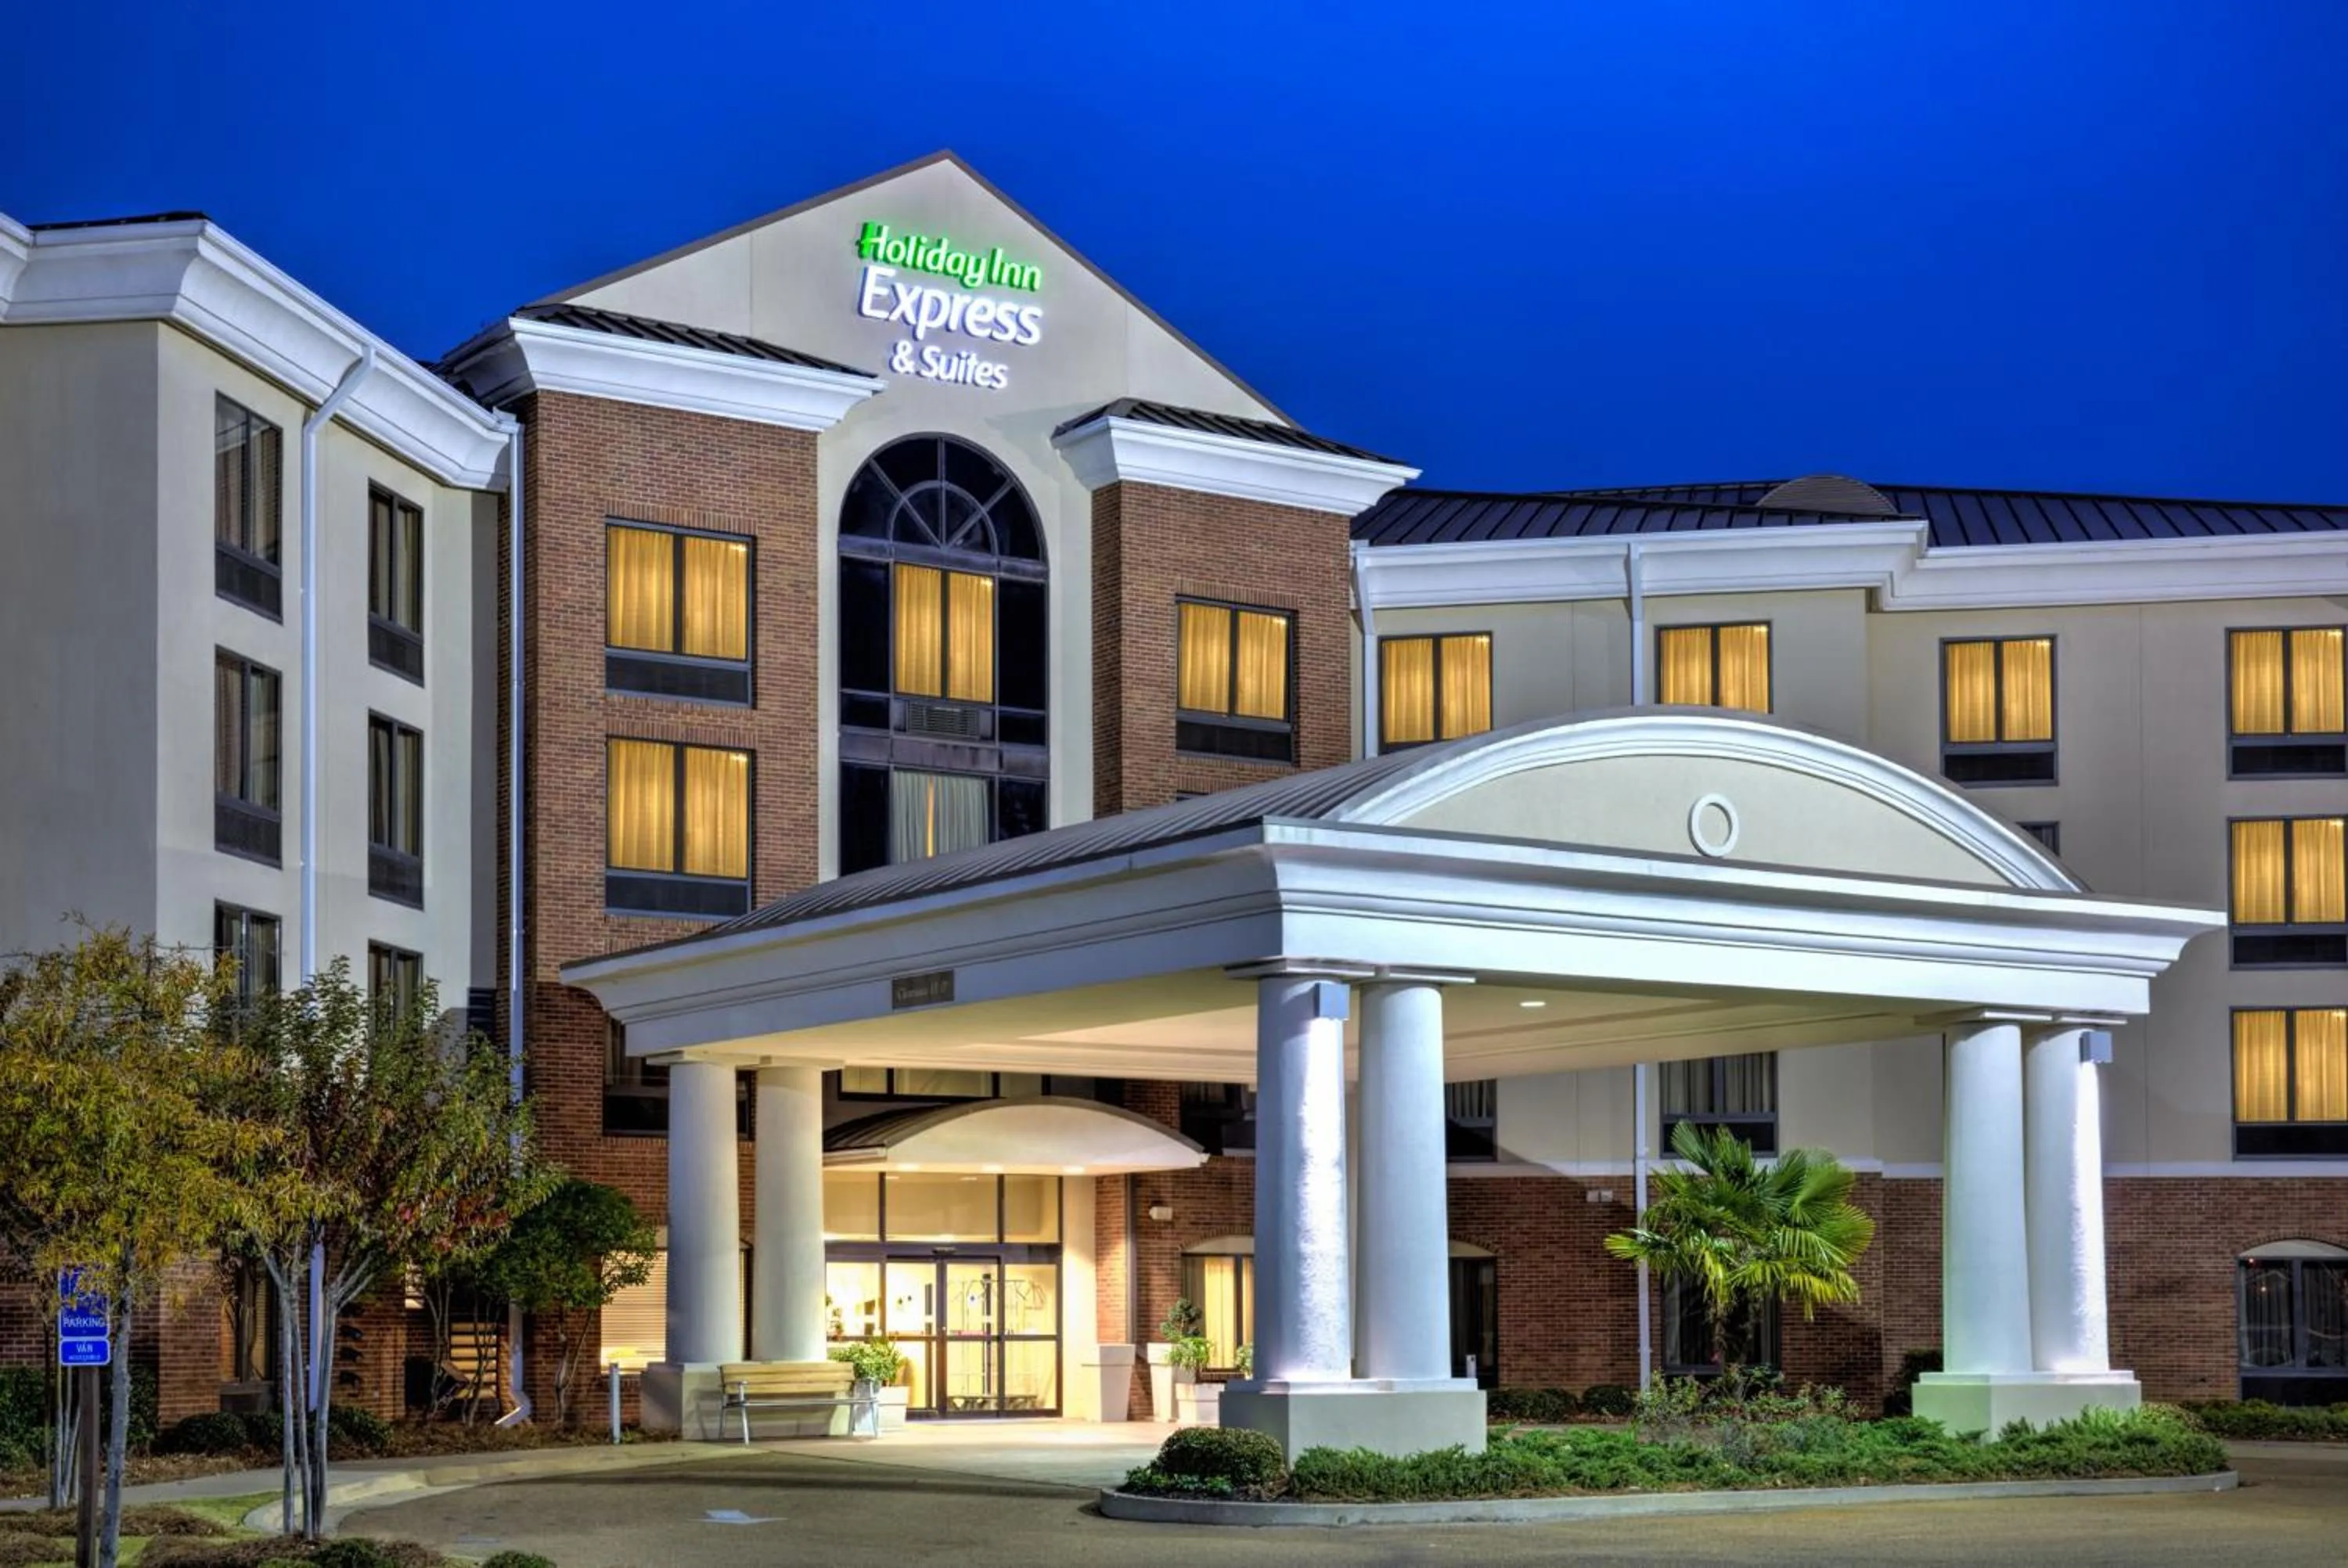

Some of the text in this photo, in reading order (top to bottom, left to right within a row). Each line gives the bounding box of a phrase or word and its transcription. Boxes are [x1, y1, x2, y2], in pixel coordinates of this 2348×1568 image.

[859, 222, 1042, 292] Holiday Inn
[859, 265, 1044, 345] Express
[890, 340, 1010, 390] & Suites
[63, 1317, 105, 1328] PARKING
[76, 1343, 93, 1353] VAN
